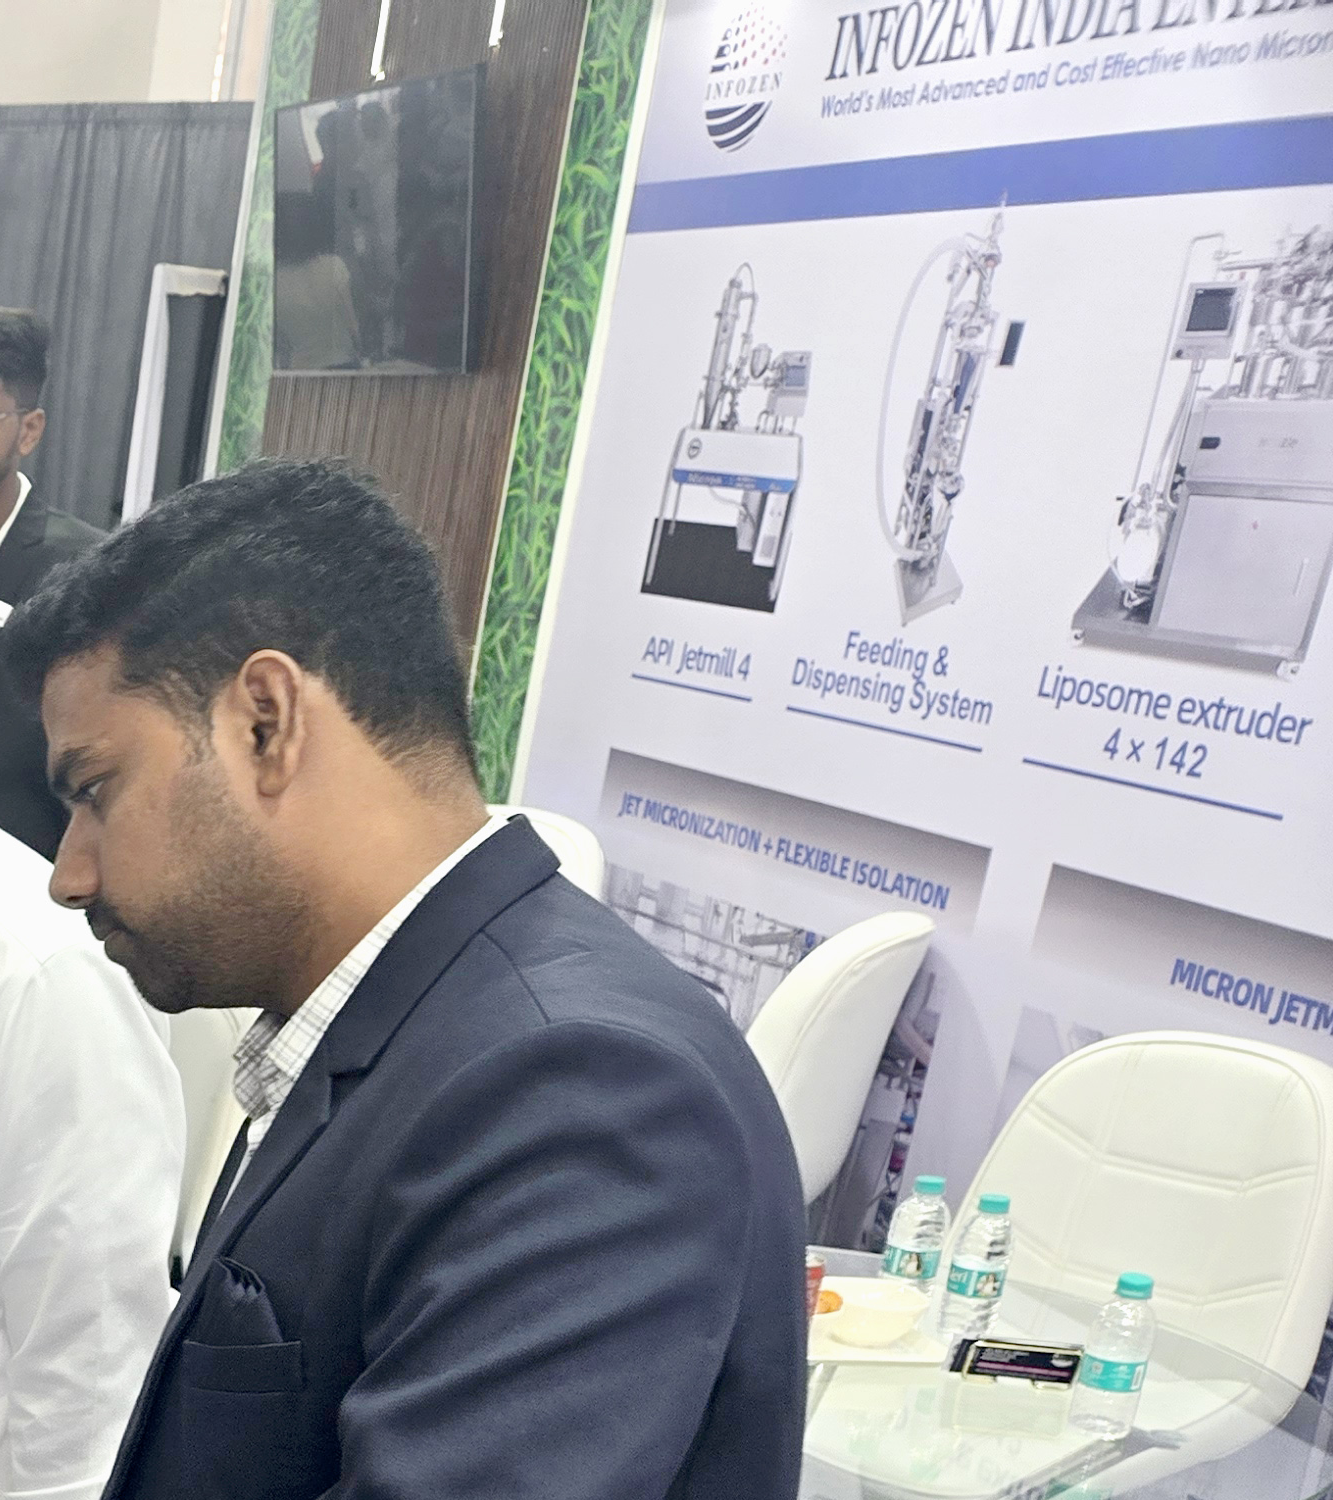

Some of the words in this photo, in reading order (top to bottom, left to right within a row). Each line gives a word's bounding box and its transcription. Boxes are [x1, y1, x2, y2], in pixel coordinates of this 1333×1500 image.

[824, 0, 1004, 82] INFOZEN
[705, 71, 783, 101] INFOZEN
[821, 89, 874, 119] World's
[876, 82, 916, 111] Most
[916, 69, 1012, 105] Advanced
[1013, 62, 1051, 92] and
[1054, 56, 1098, 87] Cost
[1100, 46, 1186, 82] Effective
[1190, 40, 1252, 70] Nano
[641, 635, 674, 665] API
[675, 639, 738, 679] Jetmill
[737, 652, 753, 682] 4
[843, 629, 930, 680] Feeding
[933, 645, 950, 677] &
[791, 657, 906, 714] Dispensing
[908, 679, 994, 725] System
[1037, 664, 1173, 721] Liposome
[1176, 695, 1314, 746] extruder
[1103, 727, 1123, 761] 4
[1155, 736, 1209, 779] 142
[617, 791, 644, 818] JET
[642, 798, 763, 855] MICRONIZATION
[763, 838, 774, 856] +
[775, 838, 852, 882] FLEXIBLE
[852, 859, 951, 911] ISOLATION
[1169, 957, 1275, 1015] MICRON
